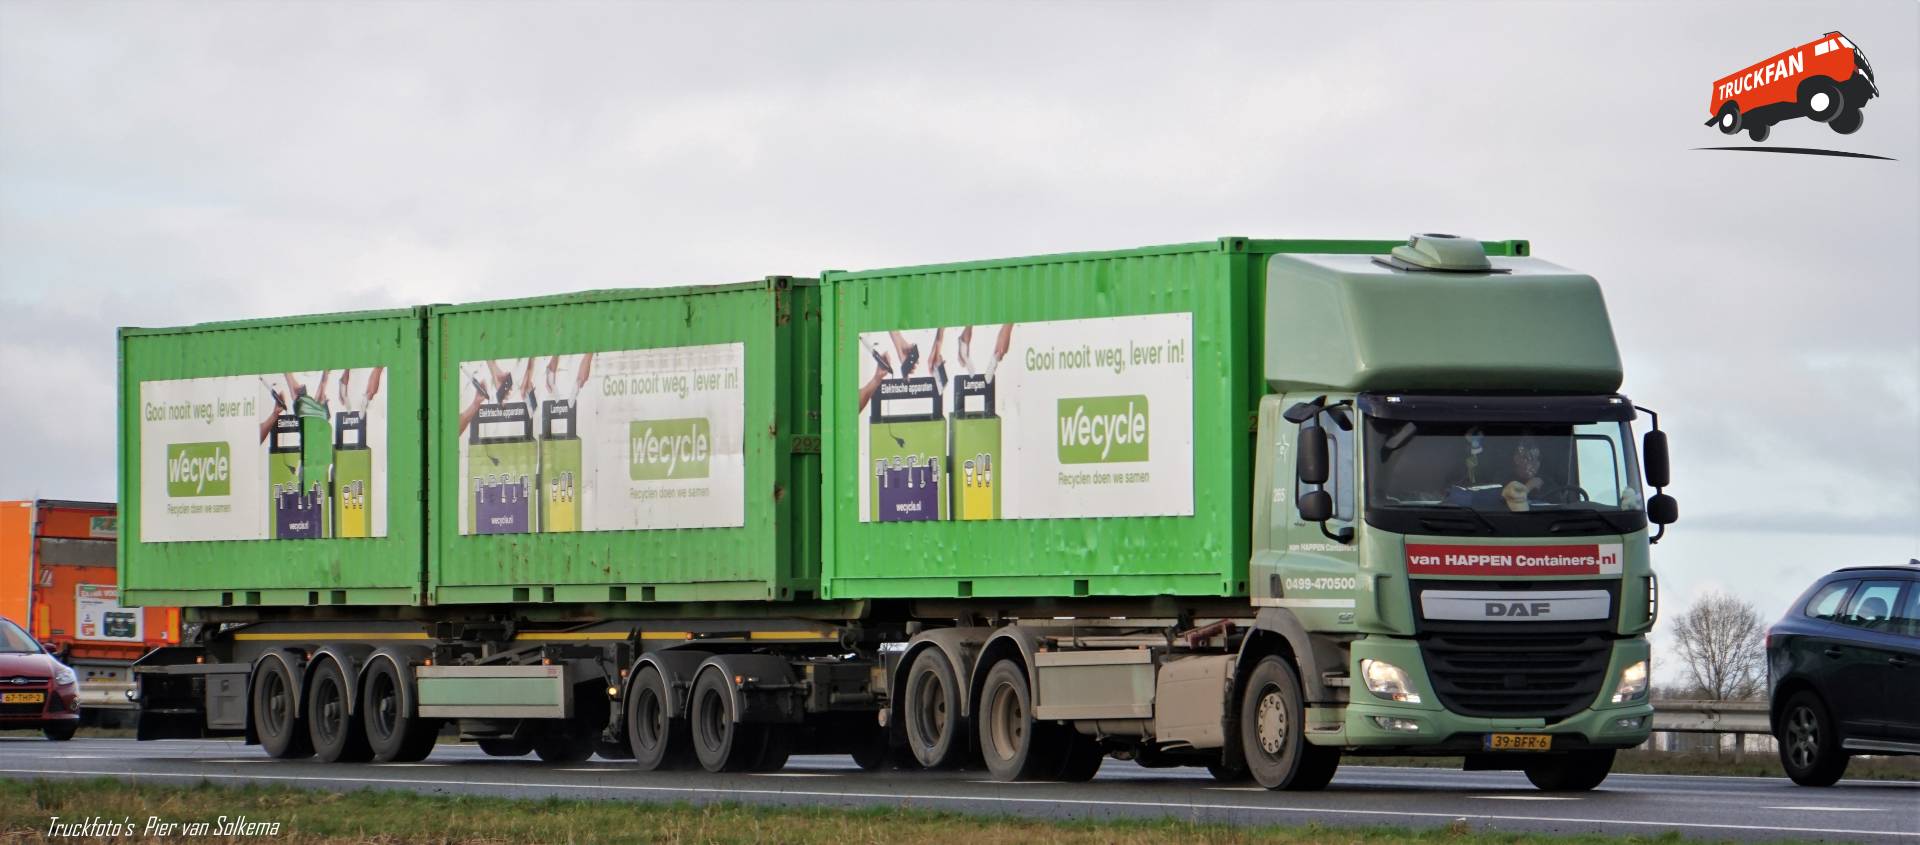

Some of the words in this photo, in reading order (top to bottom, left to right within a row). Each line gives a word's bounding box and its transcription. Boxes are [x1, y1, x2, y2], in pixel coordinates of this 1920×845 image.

[1025, 348, 1055, 372] Gooi
[1058, 344, 1091, 368] nooit
[1094, 349, 1126, 374] weg,
[1130, 340, 1163, 365] lever
[1167, 339, 1185, 364] in!
[602, 373, 628, 397] Gooi
[630, 371, 659, 394] nooit
[661, 375, 690, 398] weg,
[693, 369, 721, 392] lever
[723, 367, 739, 390] in!
[880, 382, 908, 395] Elektrische
[908, 383, 933, 396] apparaten
[963, 380, 986, 393] Lampen
[145, 401, 166, 422] Gooi
[168, 400, 191, 421] nooit
[193, 403, 214, 425] weg,
[217, 397, 241, 417] lever
[243, 396, 256, 416] in!
[550, 403, 569, 416] Lampen
[1060, 402, 1146, 460] wecycle
[632, 424, 707, 477] wecycle
[169, 446, 228, 494] wecycle
[1058, 471, 1089, 489] Recyclen
[1092, 471, 1111, 485] doen
[1113, 473, 1124, 484] we
[1125, 471, 1150, 484] samen
[630, 487, 657, 502] Recyclen
[658, 487, 675, 499] doen
[676, 489, 686, 499] we
[687, 487, 710, 498] samen
[895, 501, 922, 514] wecycle.nl
[1300, 543, 1325, 552] HAPPEN
[1410, 555, 1440, 565] van
[1445, 554, 1512, 567] HAPPEN
[1516, 553, 1617, 568] Containers.nl
[1285, 577, 1356, 590] 0499-470500
[1484, 602, 1551, 617] DAF
[1493, 735, 1548, 750] 39-BFR-6
